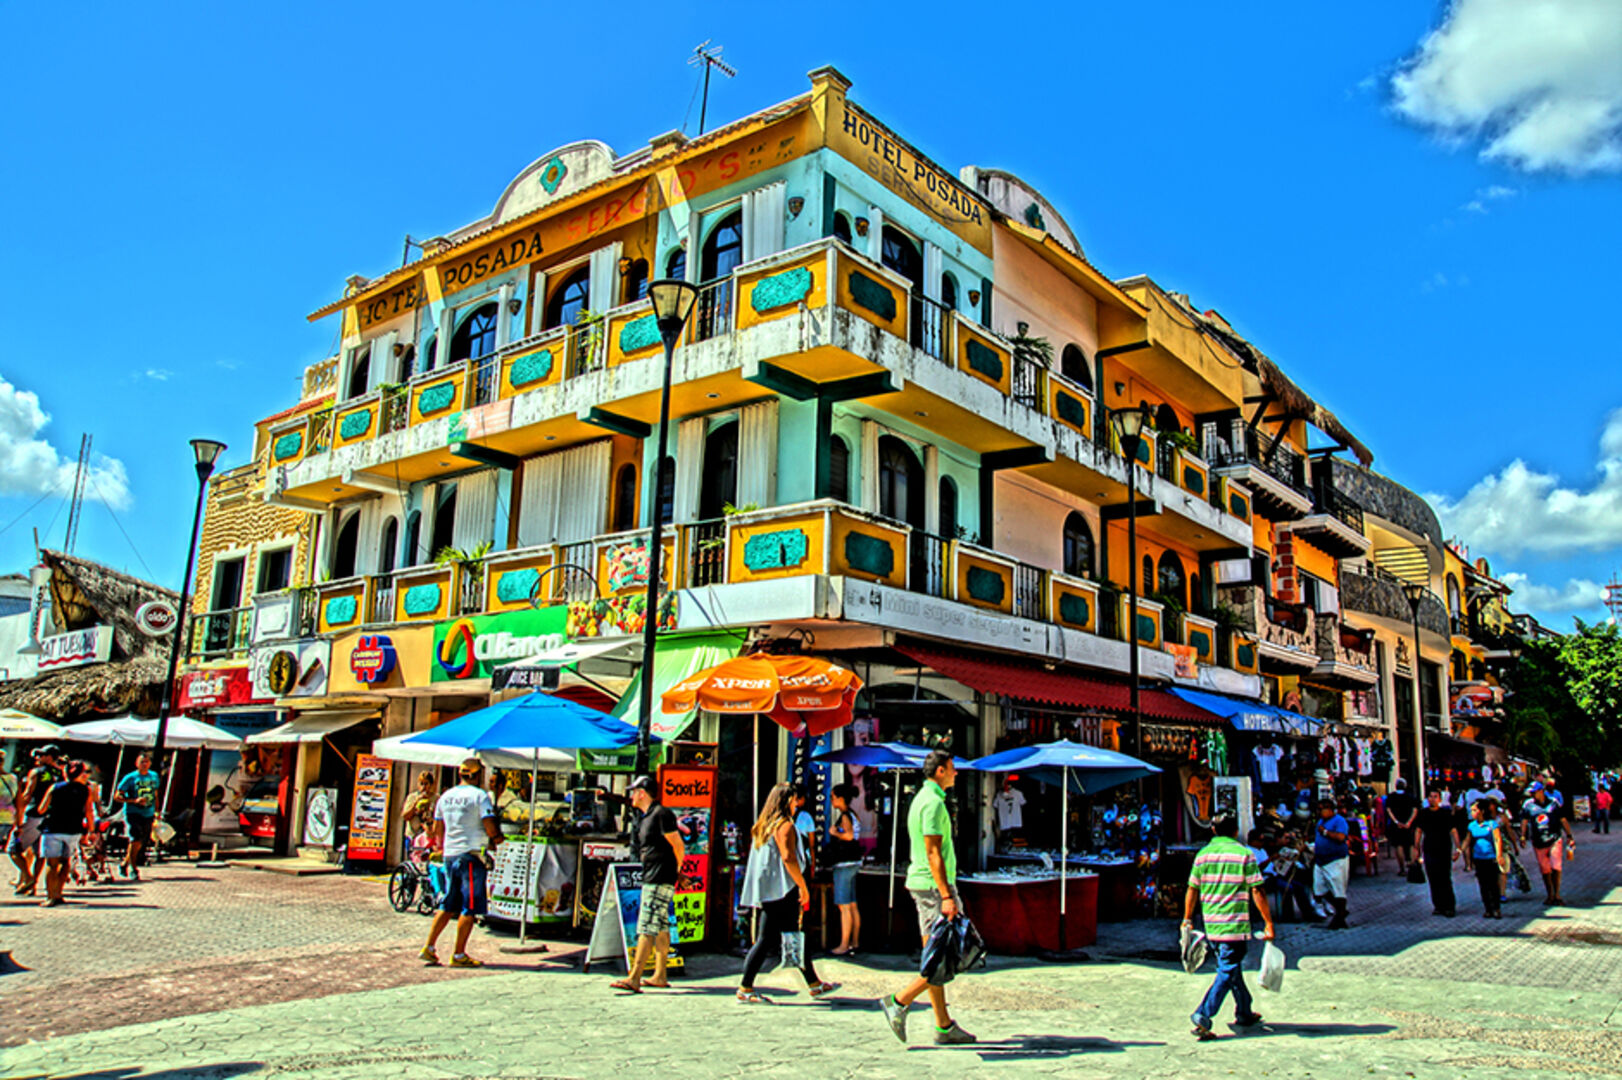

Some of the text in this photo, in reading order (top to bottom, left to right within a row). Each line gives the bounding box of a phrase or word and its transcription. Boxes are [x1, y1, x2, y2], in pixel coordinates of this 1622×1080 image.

[843, 109, 908, 174] HOTEL
[914, 161, 983, 226] POSADA
[442, 231, 543, 292] POSADA
